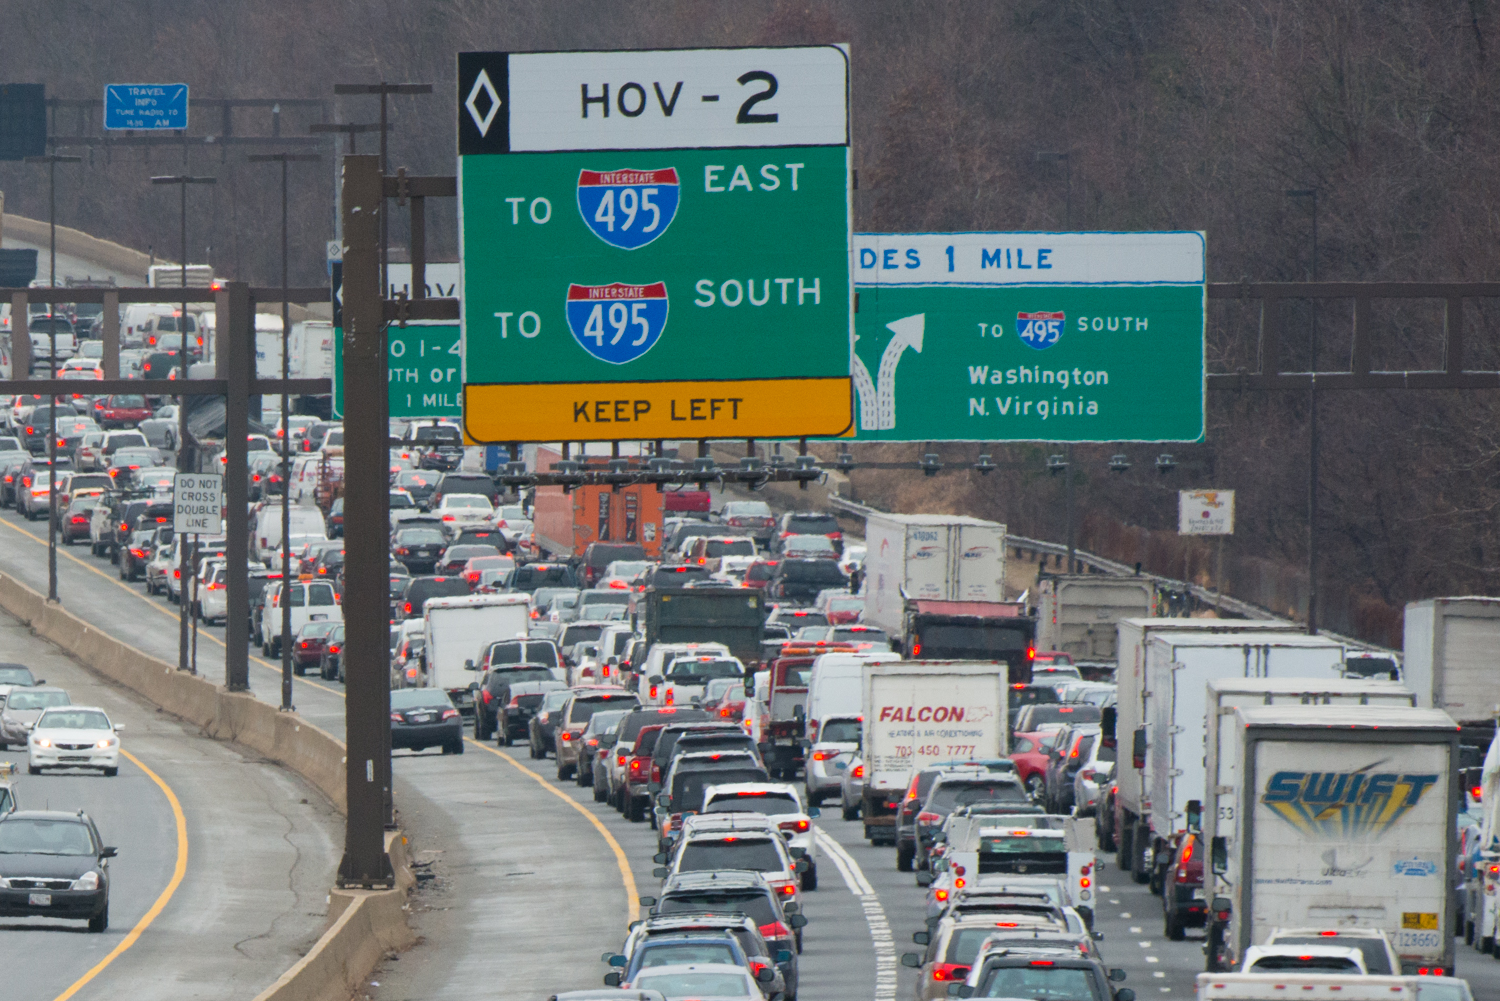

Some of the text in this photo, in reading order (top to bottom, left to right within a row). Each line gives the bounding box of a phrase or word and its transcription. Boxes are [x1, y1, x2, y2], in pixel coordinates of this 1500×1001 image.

[129, 88, 166, 96] TRAVEL
[580, 81, 684, 118] HOV
[736, 70, 779, 124] 2
[135, 98, 157, 107] INFO
[139, 109, 164, 117] RADIO
[155, 119, 170, 127] AM
[600, 172, 655, 184] INTERSTATE
[704, 163, 805, 192] EAST
[505, 197, 553, 224] TO
[595, 188, 661, 233] 495
[946, 245, 955, 272] 1
[981, 248, 1053, 269] MILE
[589, 285, 645, 299] INTERSTATE
[694, 277, 821, 307] SOUTH
[494, 311, 541, 338] TO
[583, 303, 650, 347] 495
[978, 317, 1149, 343] TO 495 SOUTH
[968, 365, 1109, 390] Washington
[407, 393, 412, 407] 1
[573, 398, 743, 422] KEEP LEFT
[996, 397, 1099, 420] Virginia
[181, 478, 218, 489] DO NOT
[181, 491, 216, 502] CROSS
[177, 504, 218, 515] DOUBLE
[186, 518, 208, 528] LINE
[879, 706, 964, 723] FALCON
[937, 729, 984, 738] CONDITIONING
[895, 744, 976, 757] 703 450 7777
[1260, 771, 1439, 806] SWIFT
[1219, 807, 1234, 820] 53
